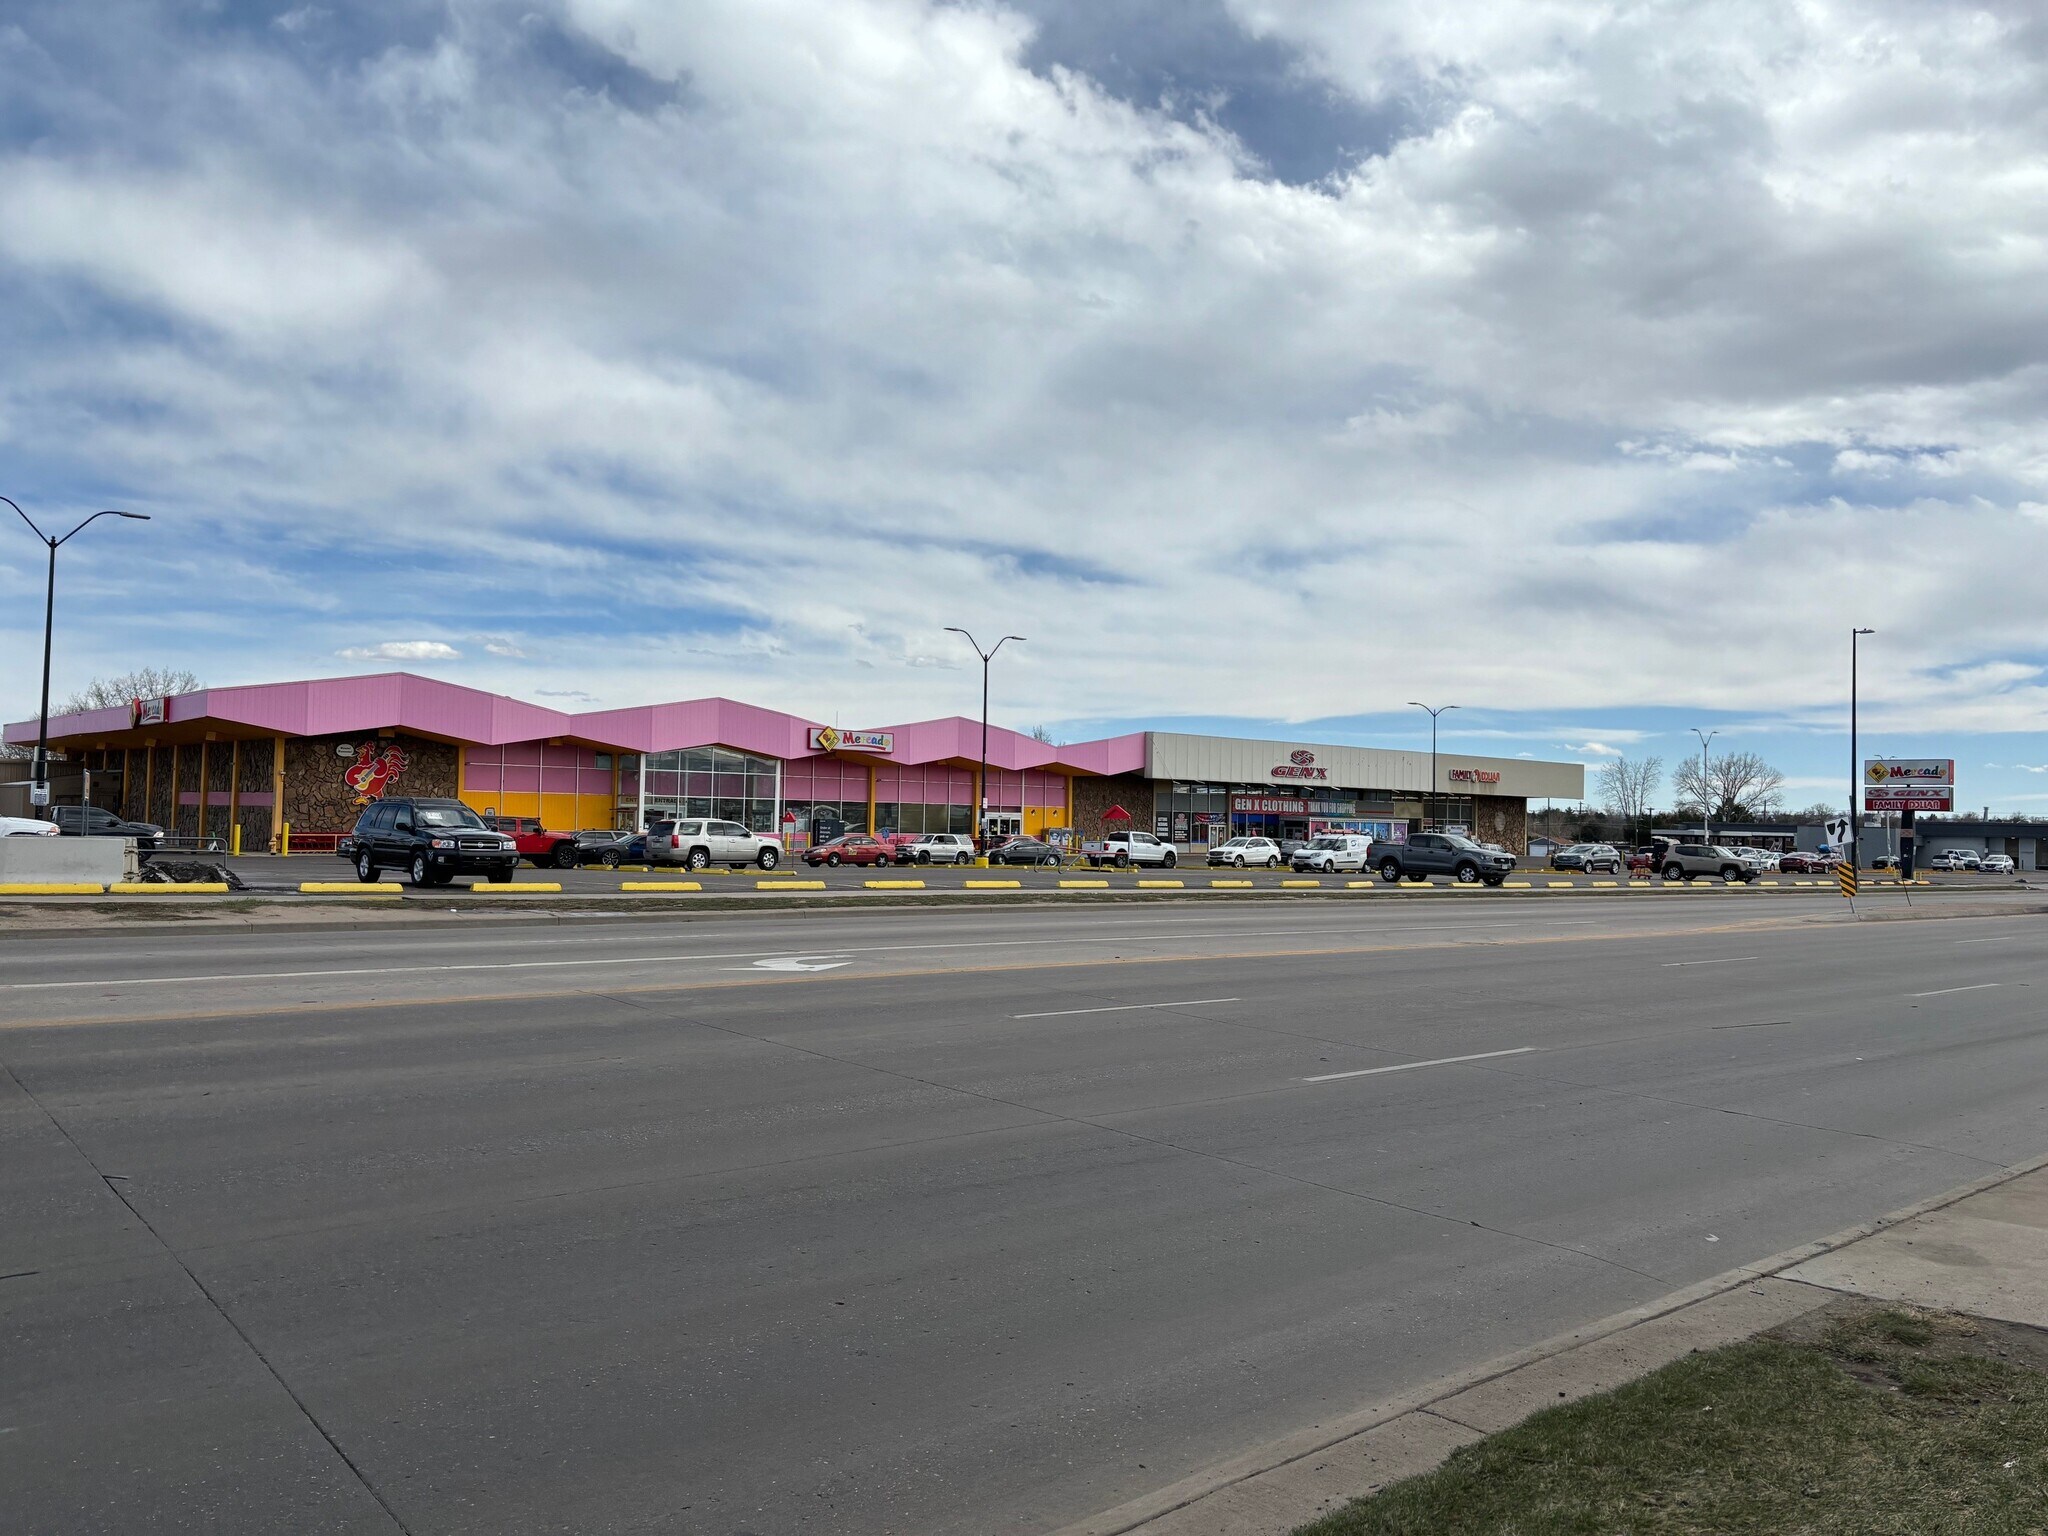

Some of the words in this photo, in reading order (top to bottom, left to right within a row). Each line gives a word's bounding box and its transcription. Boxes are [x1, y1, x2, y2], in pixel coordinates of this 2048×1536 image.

[842, 731, 891, 746] Mercado
[1889, 765, 1947, 777] Mercado
[1234, 798, 1252, 811] GEN
[1254, 799, 1260, 811] X
[1262, 799, 1304, 812] CLOTHING
[1873, 800, 1905, 809] FAMILY
[1908, 800, 1940, 810] DOLLAR
